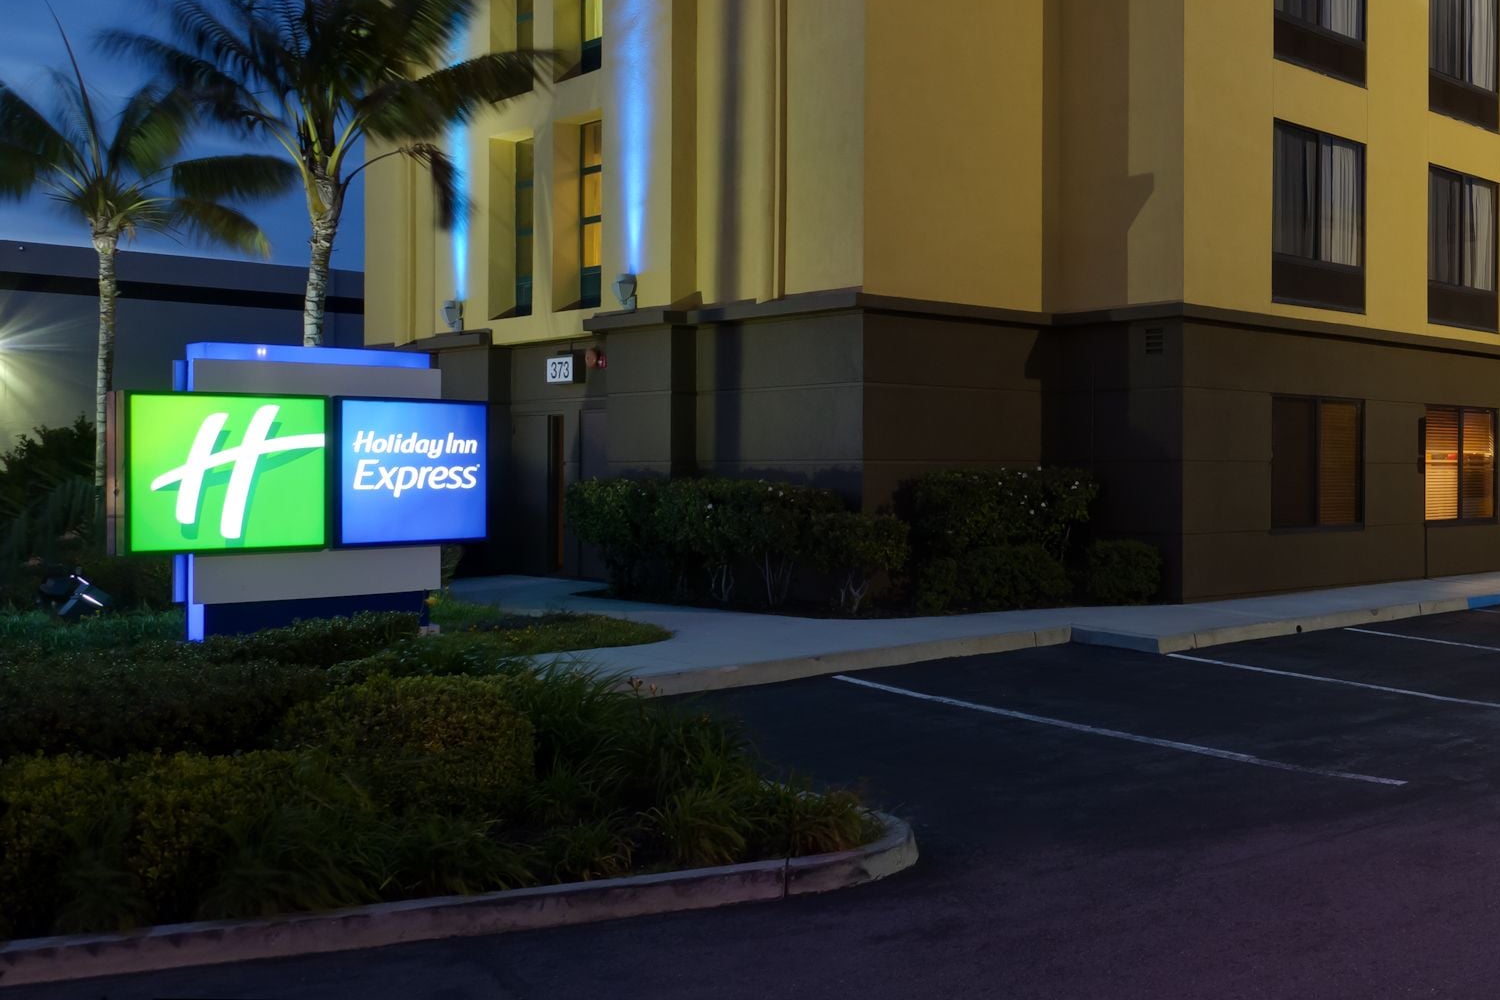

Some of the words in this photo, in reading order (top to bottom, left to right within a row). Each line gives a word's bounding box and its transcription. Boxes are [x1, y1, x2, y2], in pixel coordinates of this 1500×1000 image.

[550, 361, 570, 379] 373
[352, 430, 444, 459] Holiday
[446, 432, 478, 454] Inn
[353, 459, 479, 498] Express
